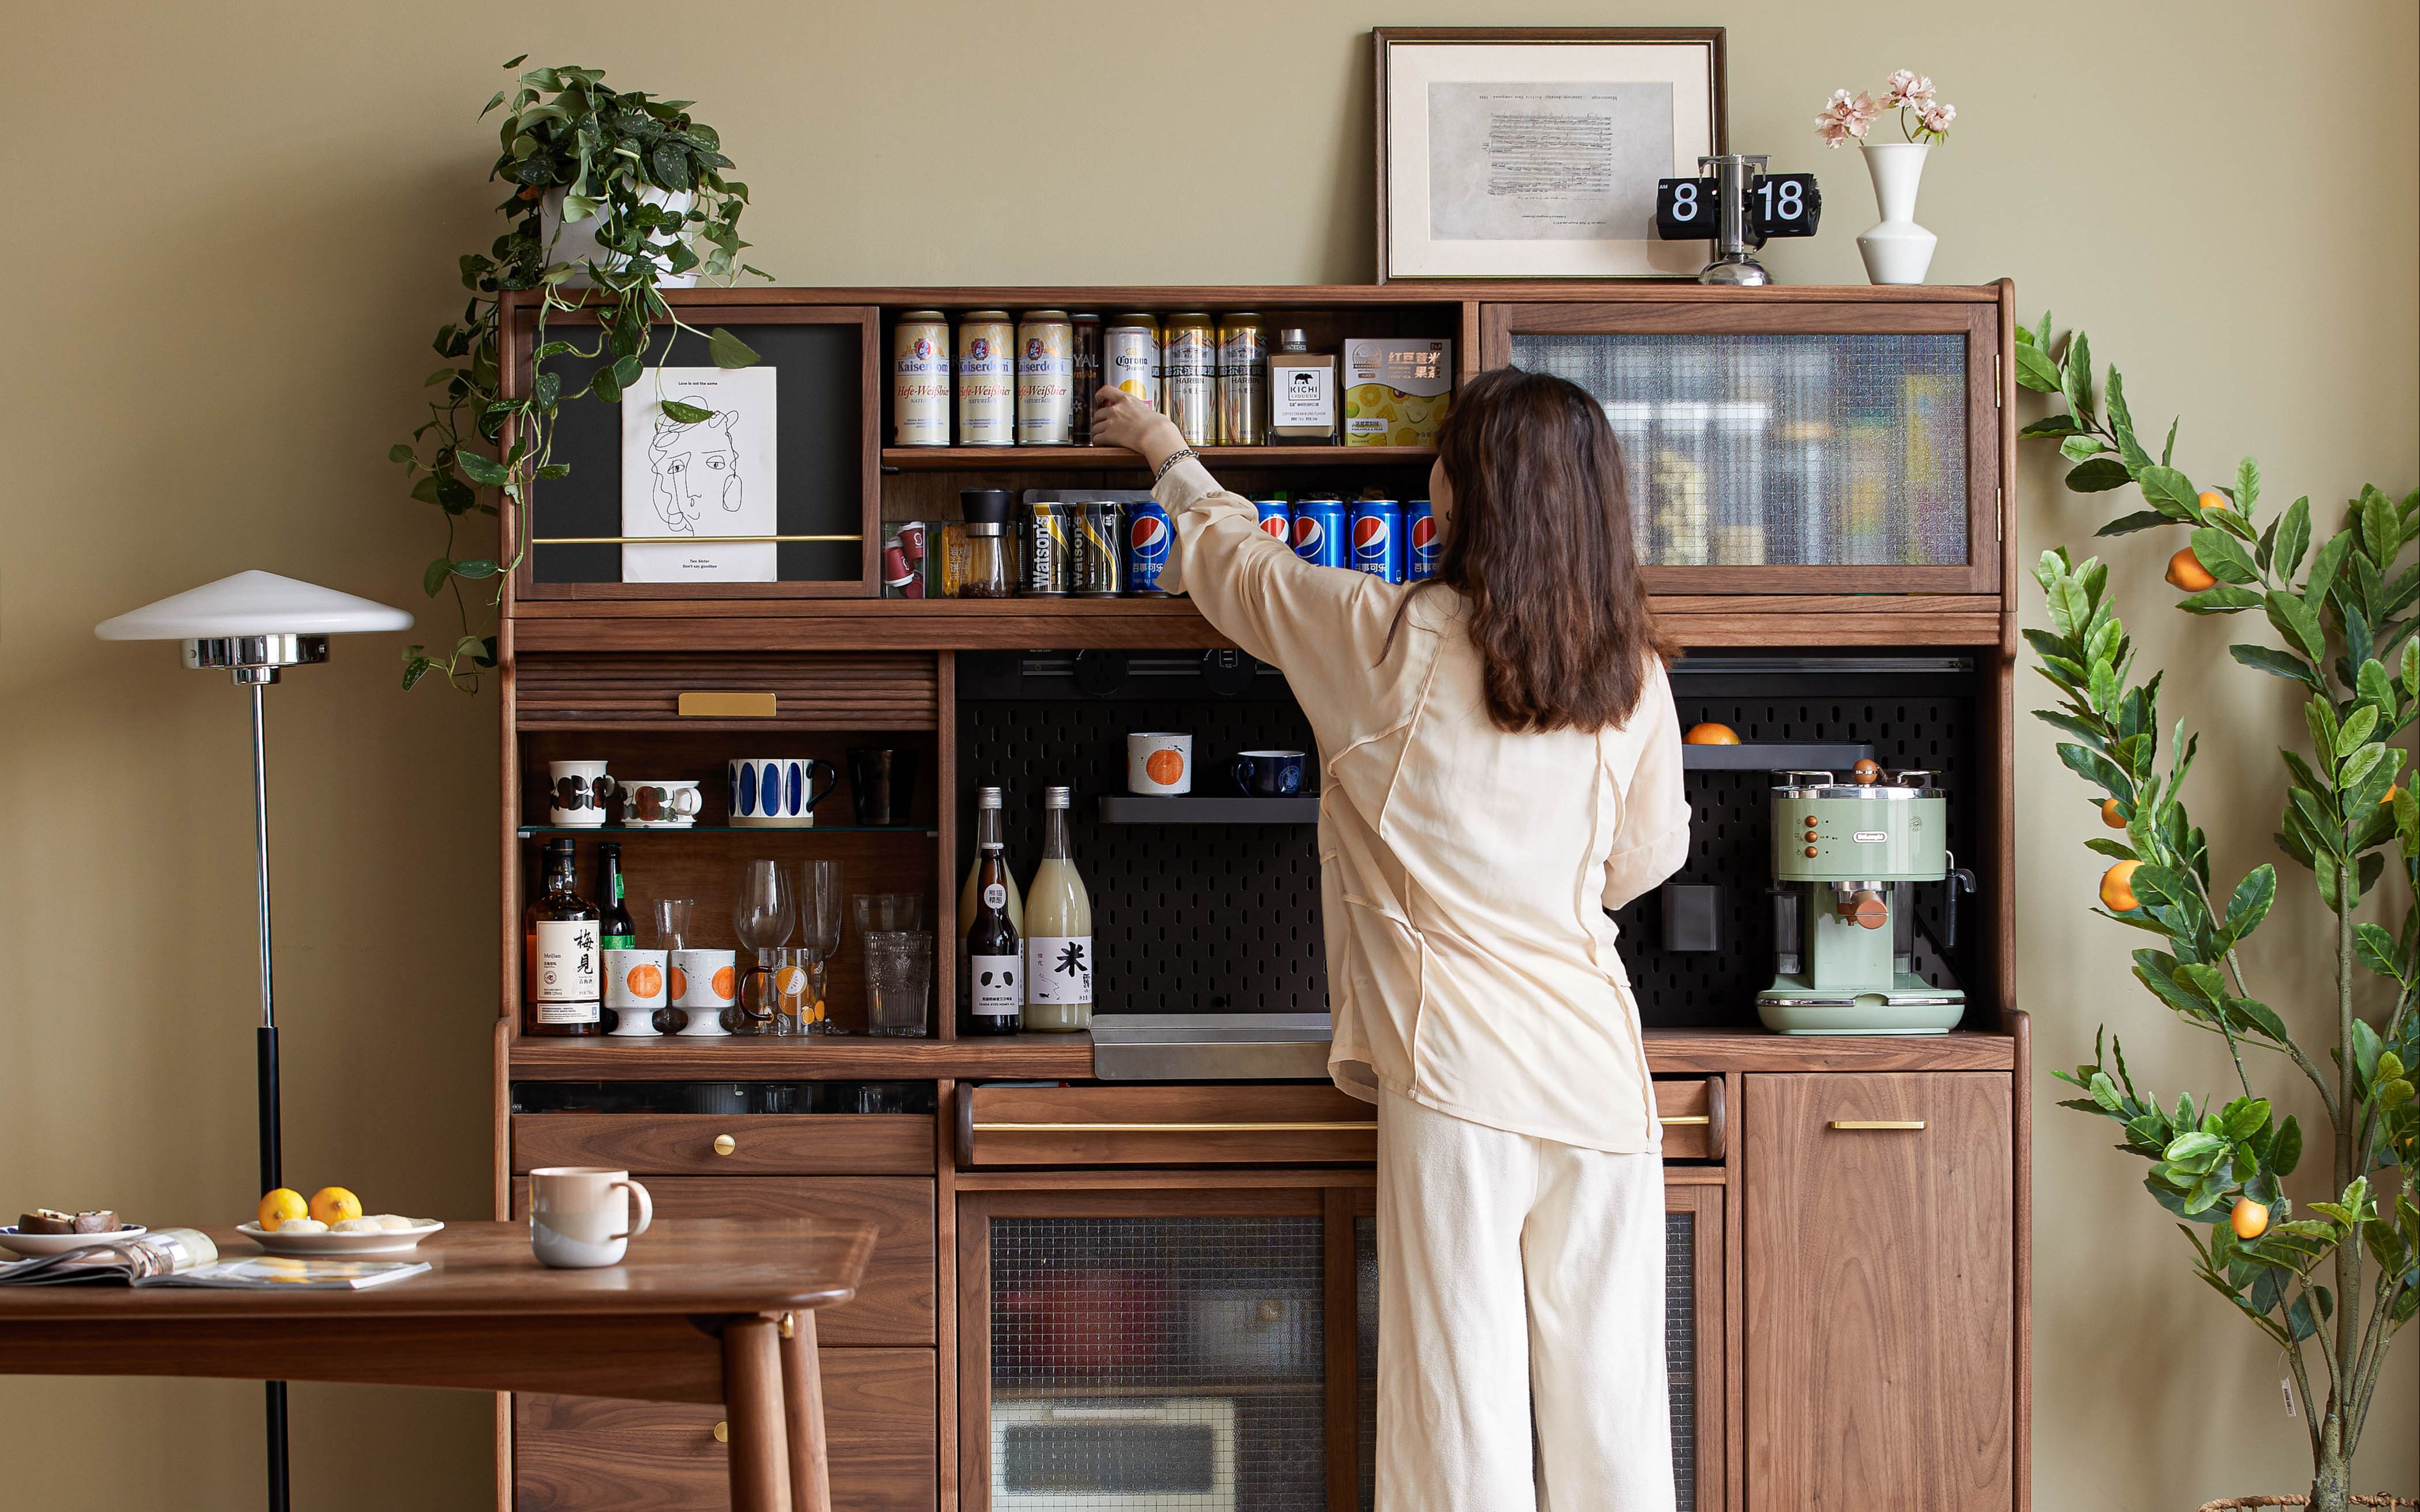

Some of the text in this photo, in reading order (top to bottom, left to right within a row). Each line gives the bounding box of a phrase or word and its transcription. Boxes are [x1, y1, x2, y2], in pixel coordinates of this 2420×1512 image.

[1673, 183, 1698, 222] 8
[1757, 181, 1802, 220] 18
[1073, 354, 1099, 367] YAL
[1116, 355, 1147, 368] Corona
[1220, 366, 1263, 376] 哈尔滨啤
[1033, 515, 1049, 588] Watson's
[1073, 517, 1083, 587] Watson's
[1132, 563, 1164, 572] 百事可乐
[1355, 563, 1386, 572] 百事可乐
[1415, 563, 1439, 572] 百事可
[1054, 941, 1088, 977] 米
